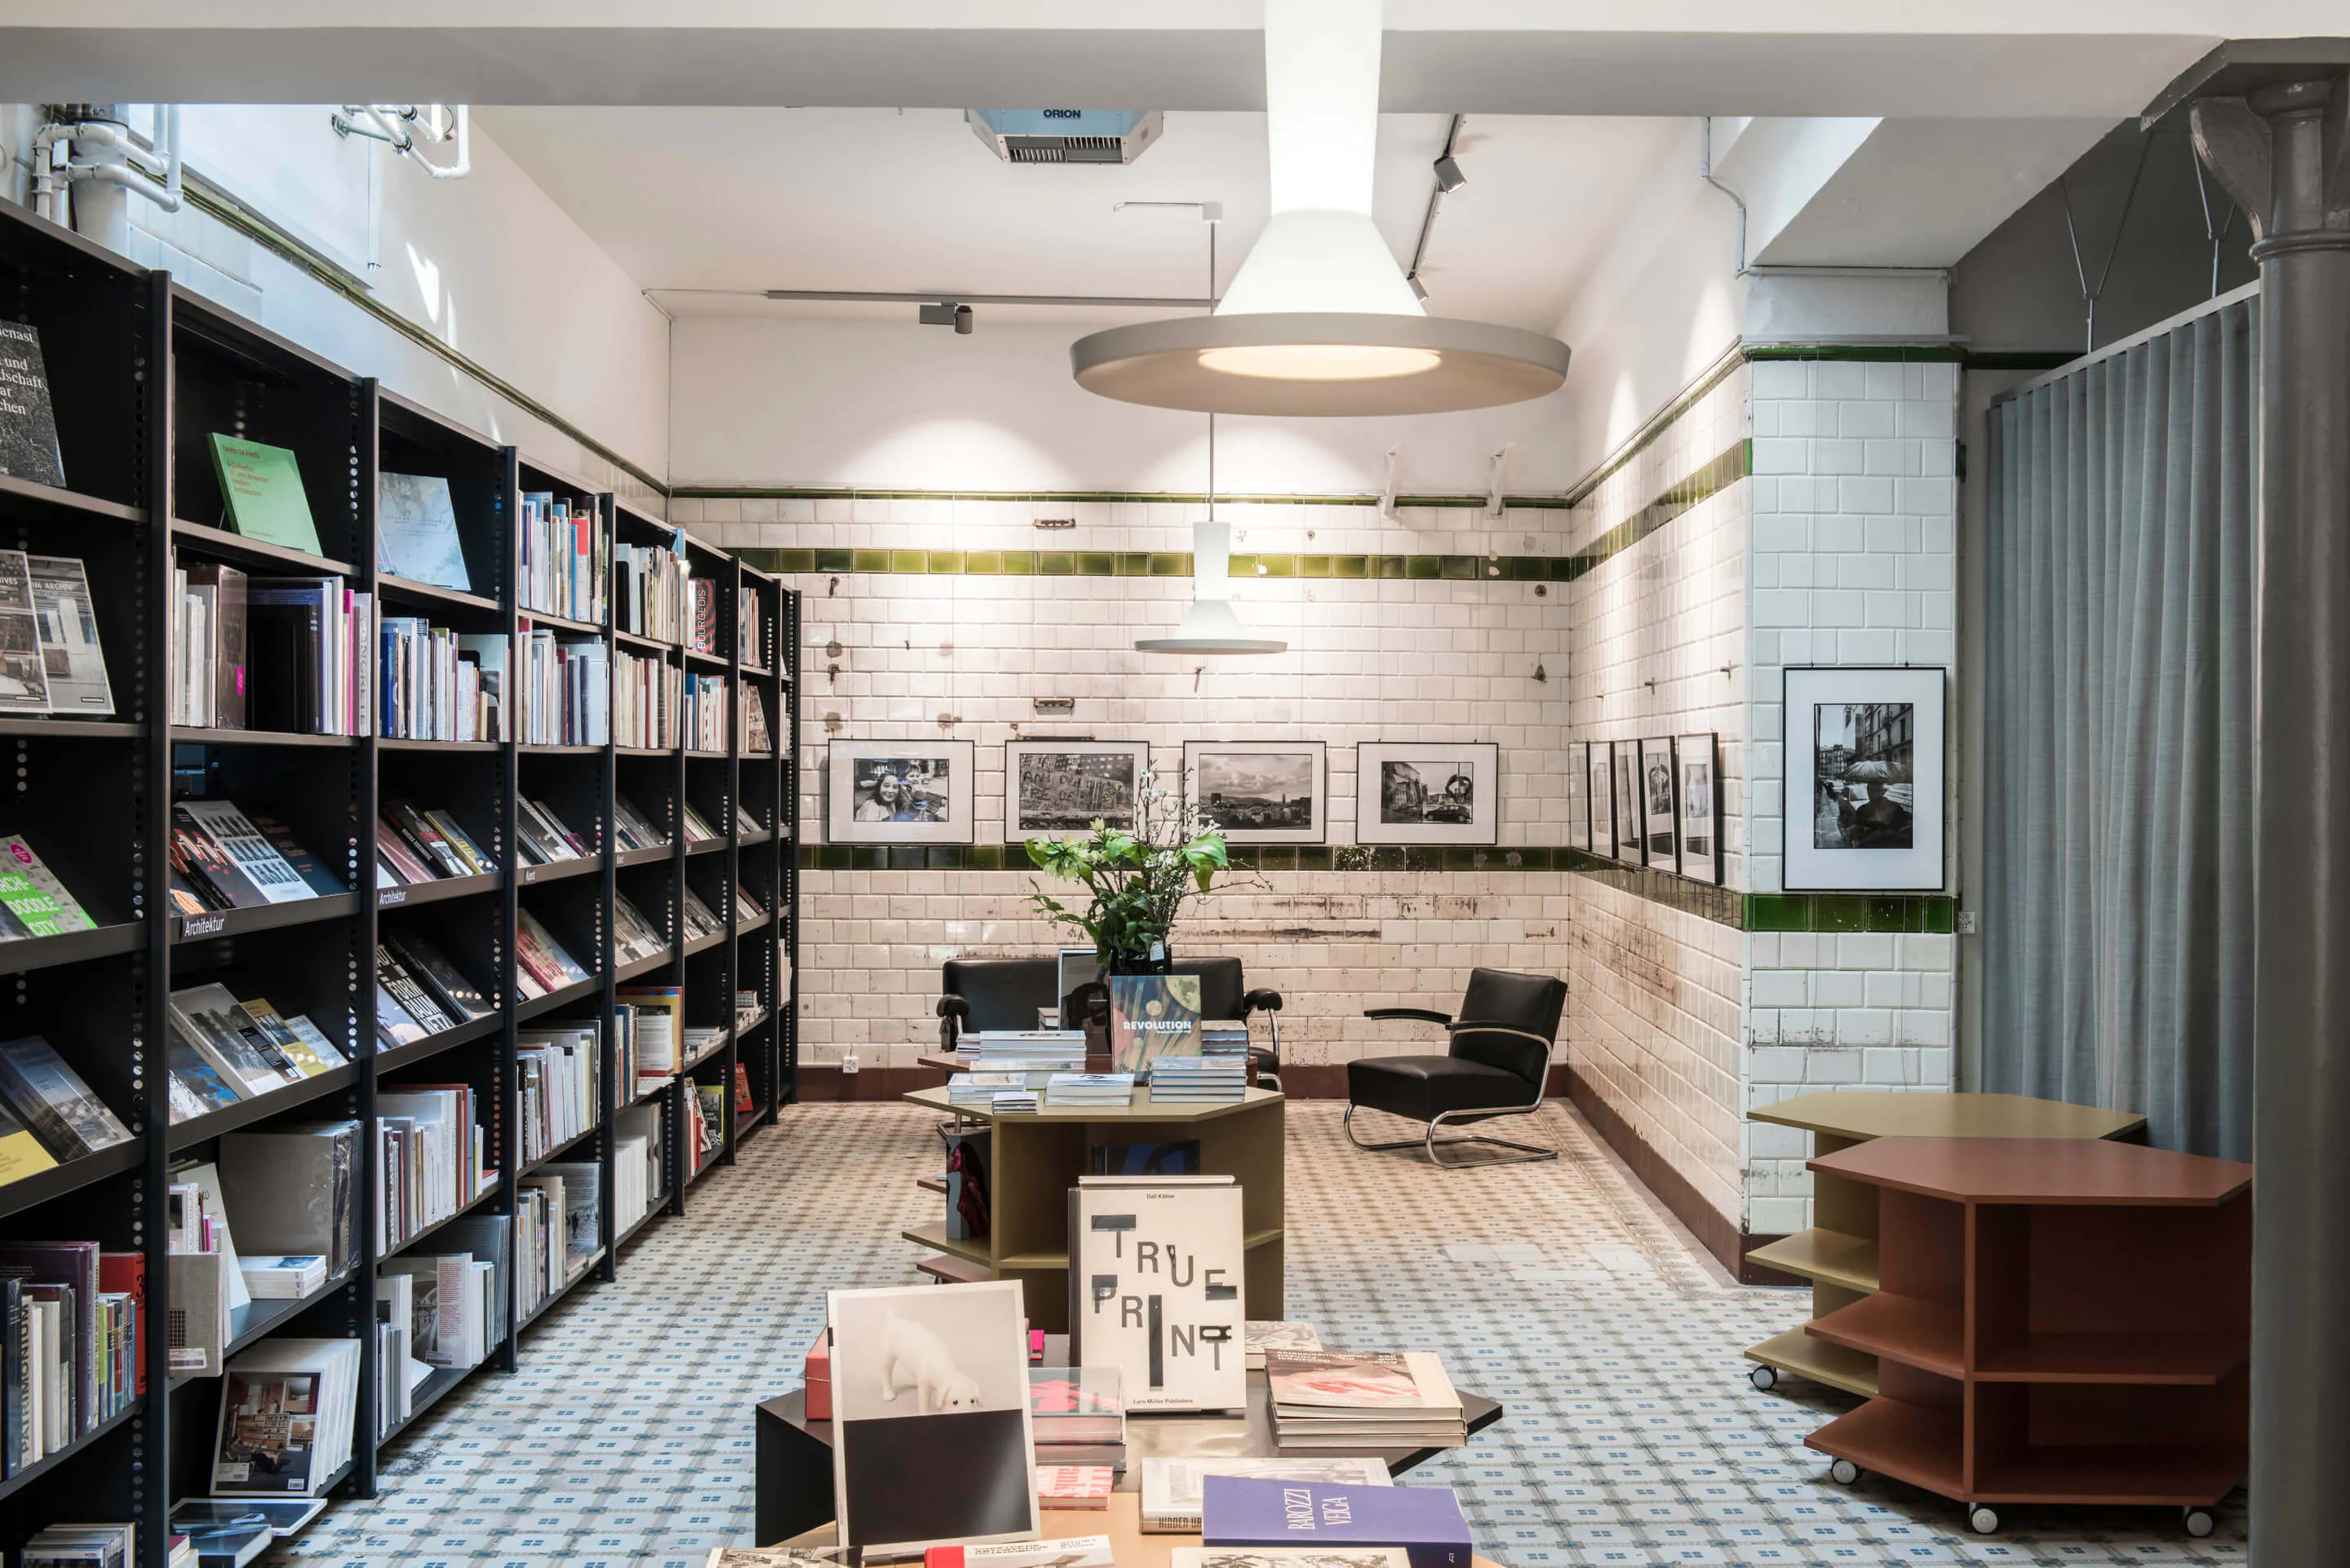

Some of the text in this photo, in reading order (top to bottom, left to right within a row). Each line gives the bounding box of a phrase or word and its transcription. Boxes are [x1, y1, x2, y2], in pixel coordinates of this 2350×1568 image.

[1044, 109, 1081, 118] ORION
[5, 357, 27, 371] und
[698, 589, 706, 649] BOURGEOIS
[5, 897, 60, 915] DOODLE
[379, 890, 406, 906] Architektur
[28, 920, 61, 937] CITY
[184, 916, 225, 937] Architektur
[385, 977, 424, 1001] FORM
[402, 994, 441, 1018] RAUM
[1123, 1021, 1191, 1030] REVOLUTION
[1091, 1214, 1238, 1300] TRUE
[1092, 1274, 1232, 1392] PRINT
[21, 1303, 30, 1454] PATRIMONIUM
[1284, 1488, 1315, 1530] BAROZZI
[1322, 1496, 1352, 1526] VEIGA
[1159, 1517, 1188, 1528] HIDDEN
